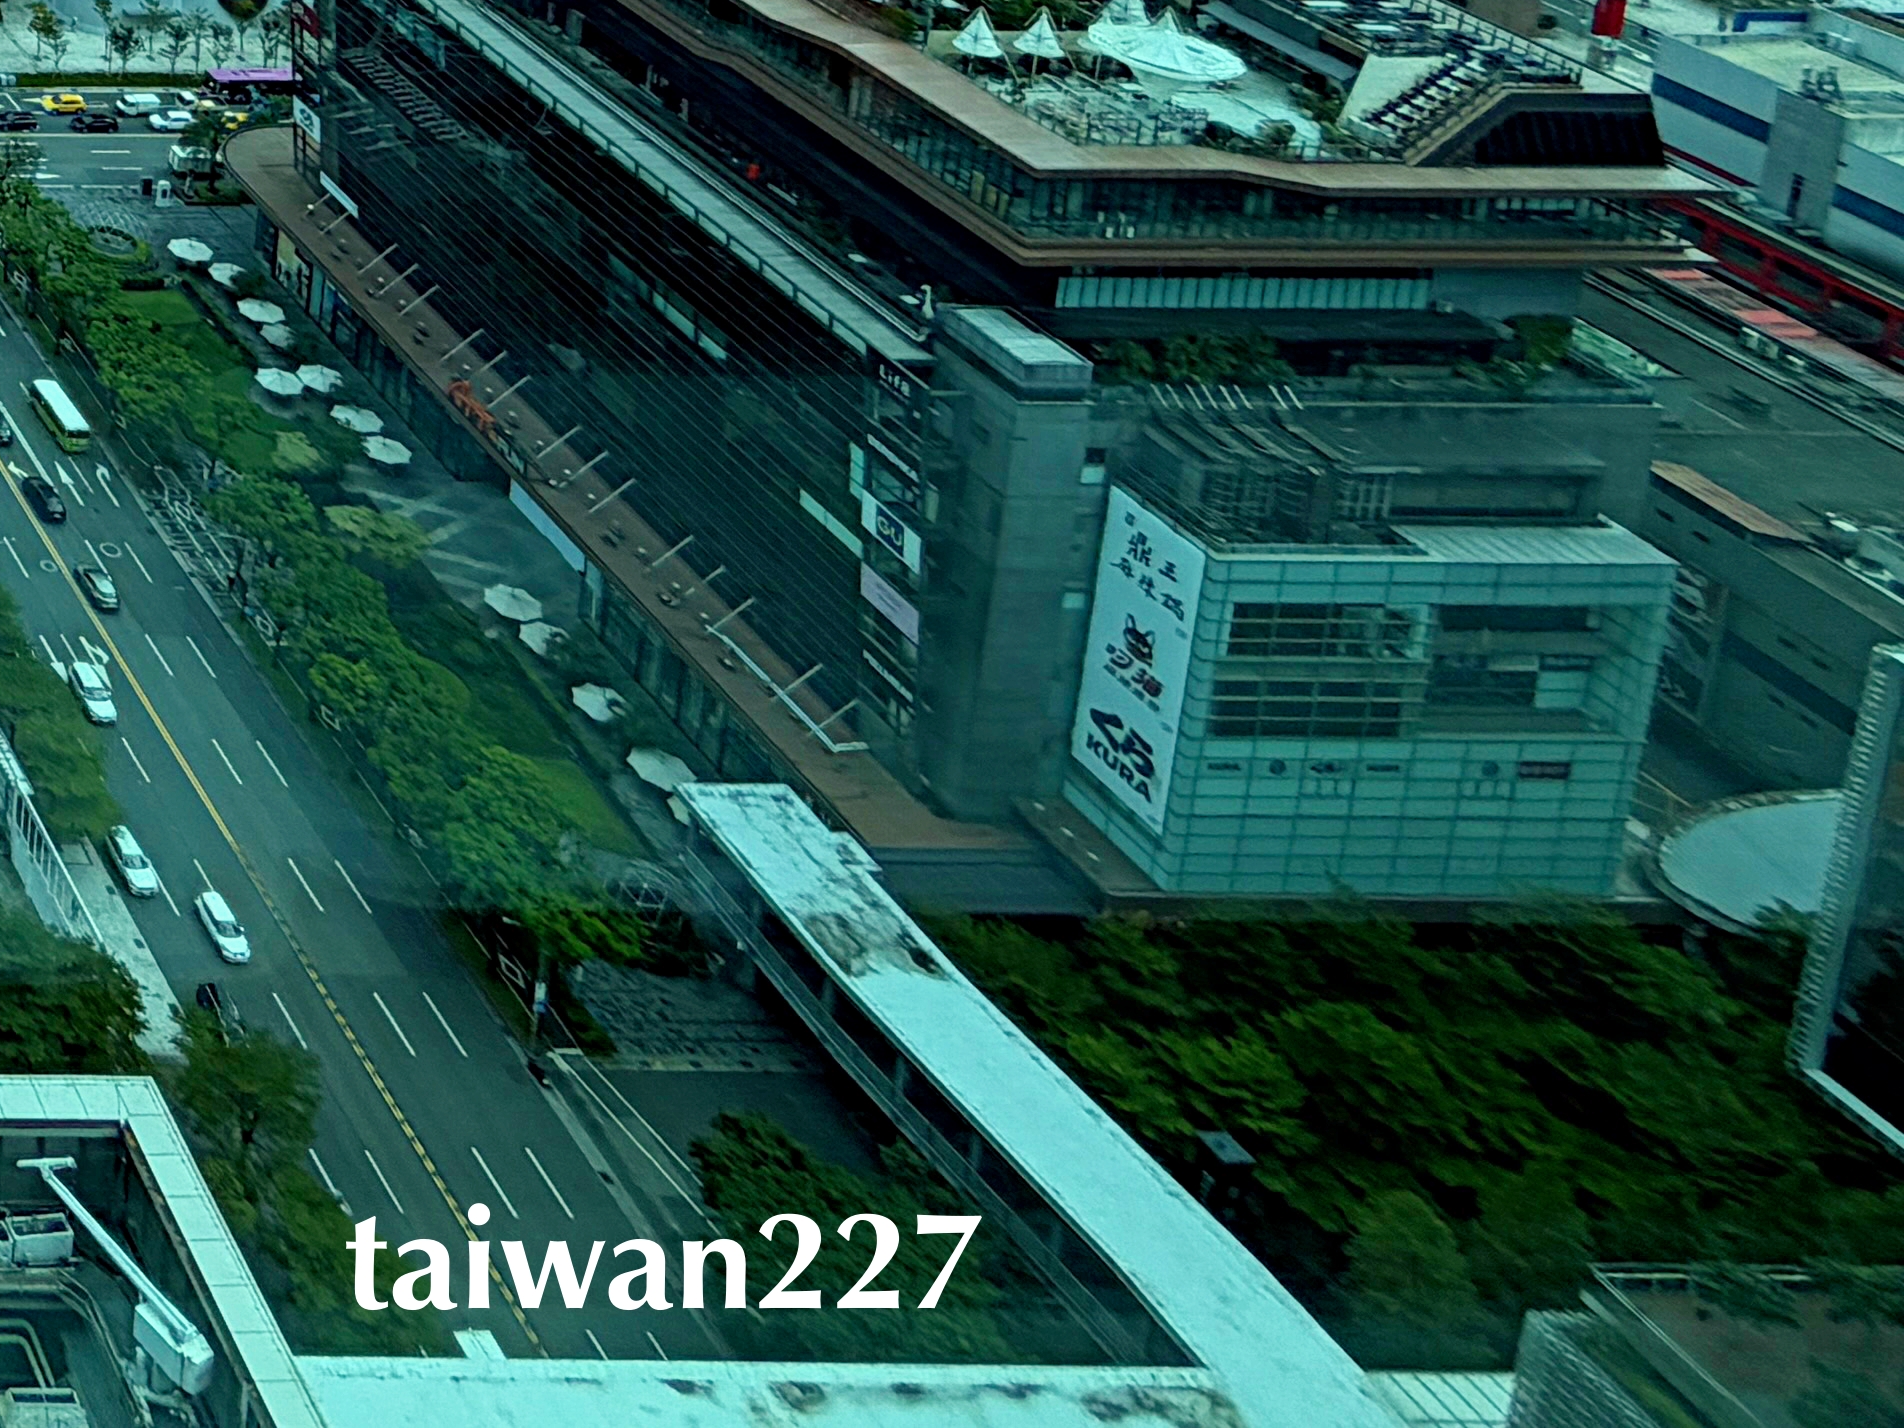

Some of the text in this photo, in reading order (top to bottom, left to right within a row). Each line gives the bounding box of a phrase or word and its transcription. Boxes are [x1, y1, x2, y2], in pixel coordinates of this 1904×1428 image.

[877, 515, 903, 546] GU
[1126, 530, 1178, 583] 鼎王
[1086, 732, 1153, 804] KURA
[1089, 707, 1156, 780] くら
